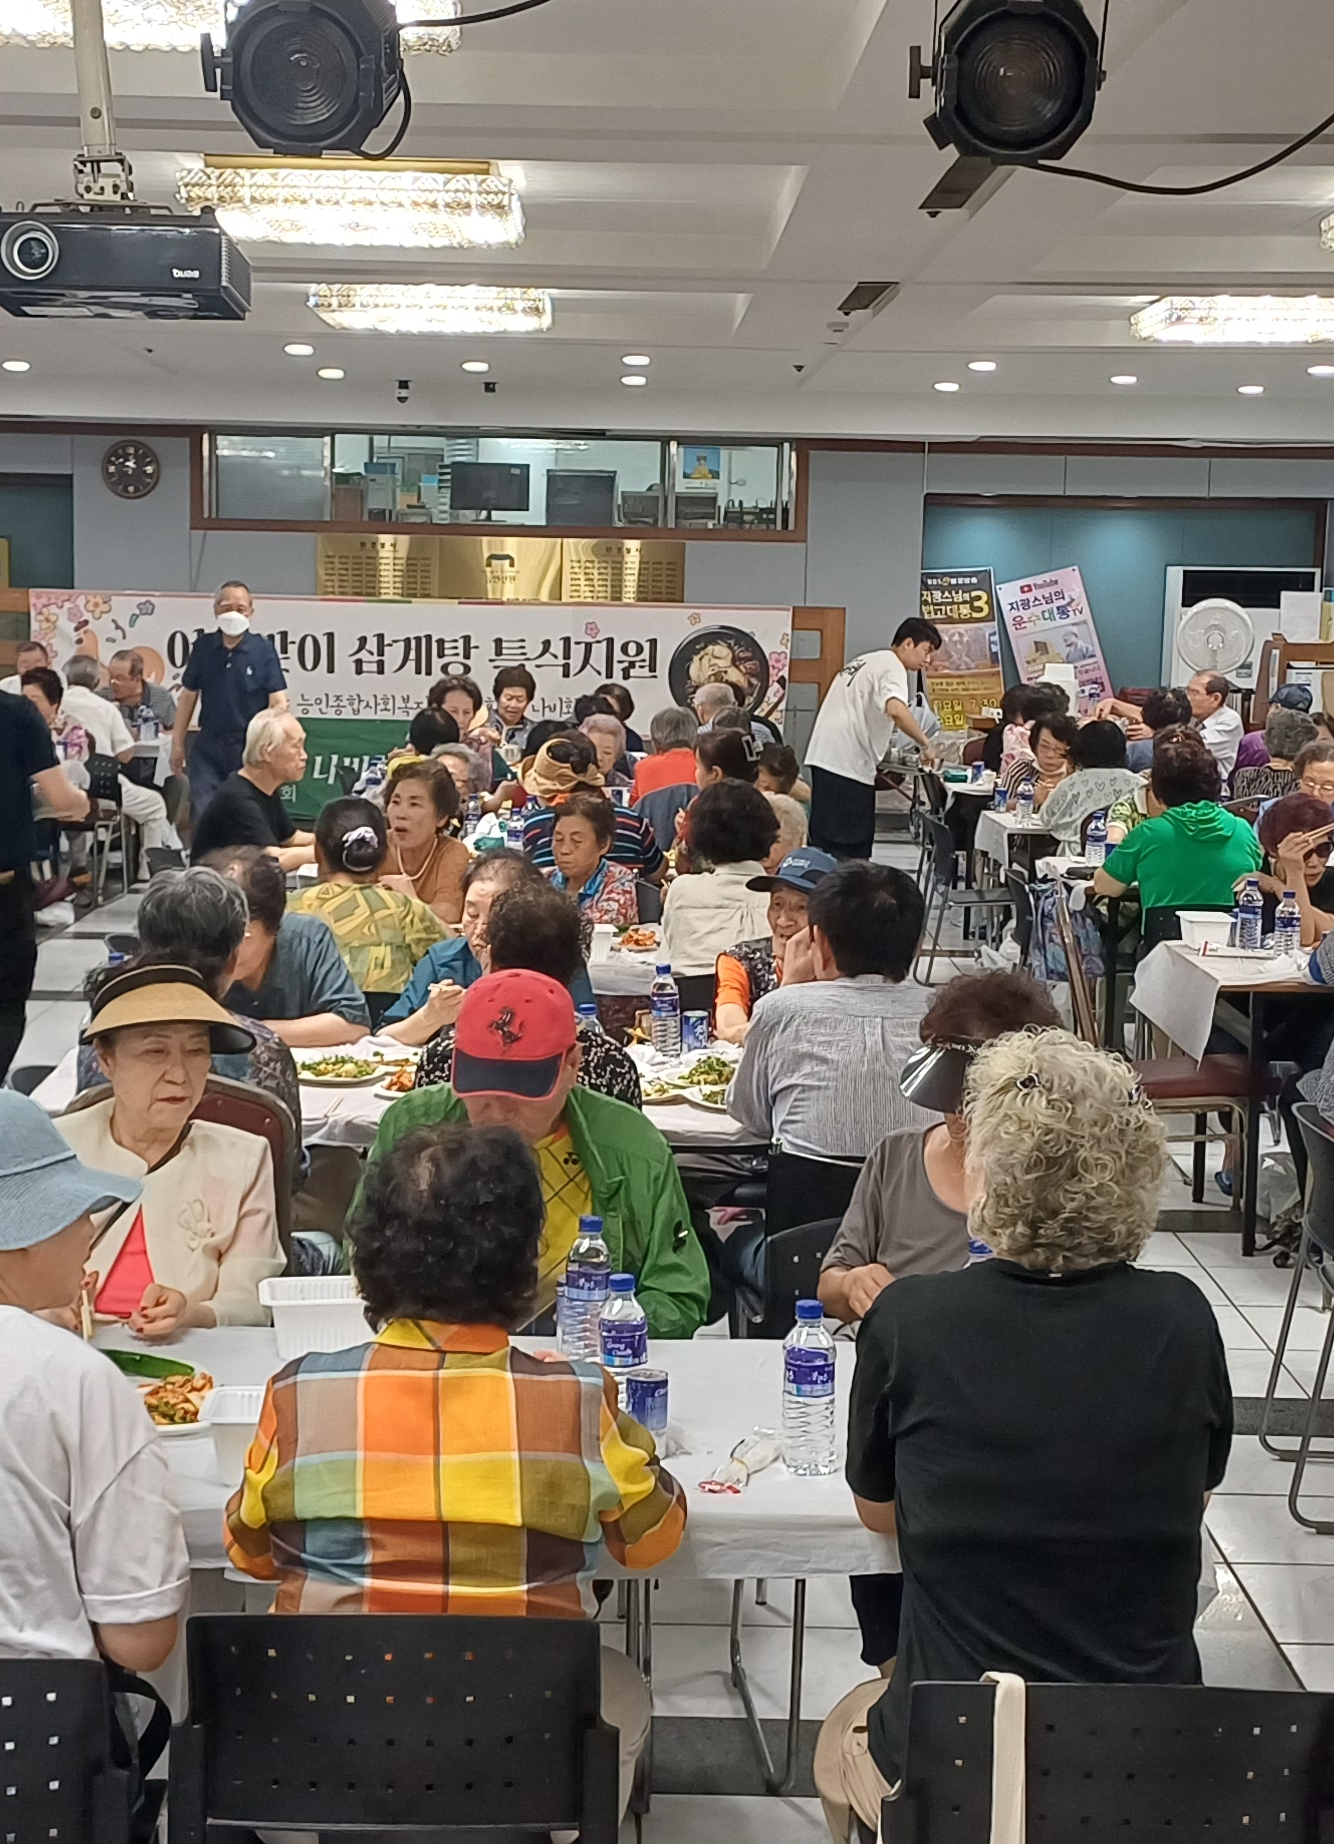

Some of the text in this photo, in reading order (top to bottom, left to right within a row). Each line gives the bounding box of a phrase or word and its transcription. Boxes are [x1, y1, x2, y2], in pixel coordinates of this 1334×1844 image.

[970, 590, 989, 618] 3
[1008, 589, 1066, 612] 지광스님의
[1012, 604, 1084, 631] 운수대통 TV
[348, 633, 479, 676] 삼계탕
[488, 636, 658, 680] 특식지원
